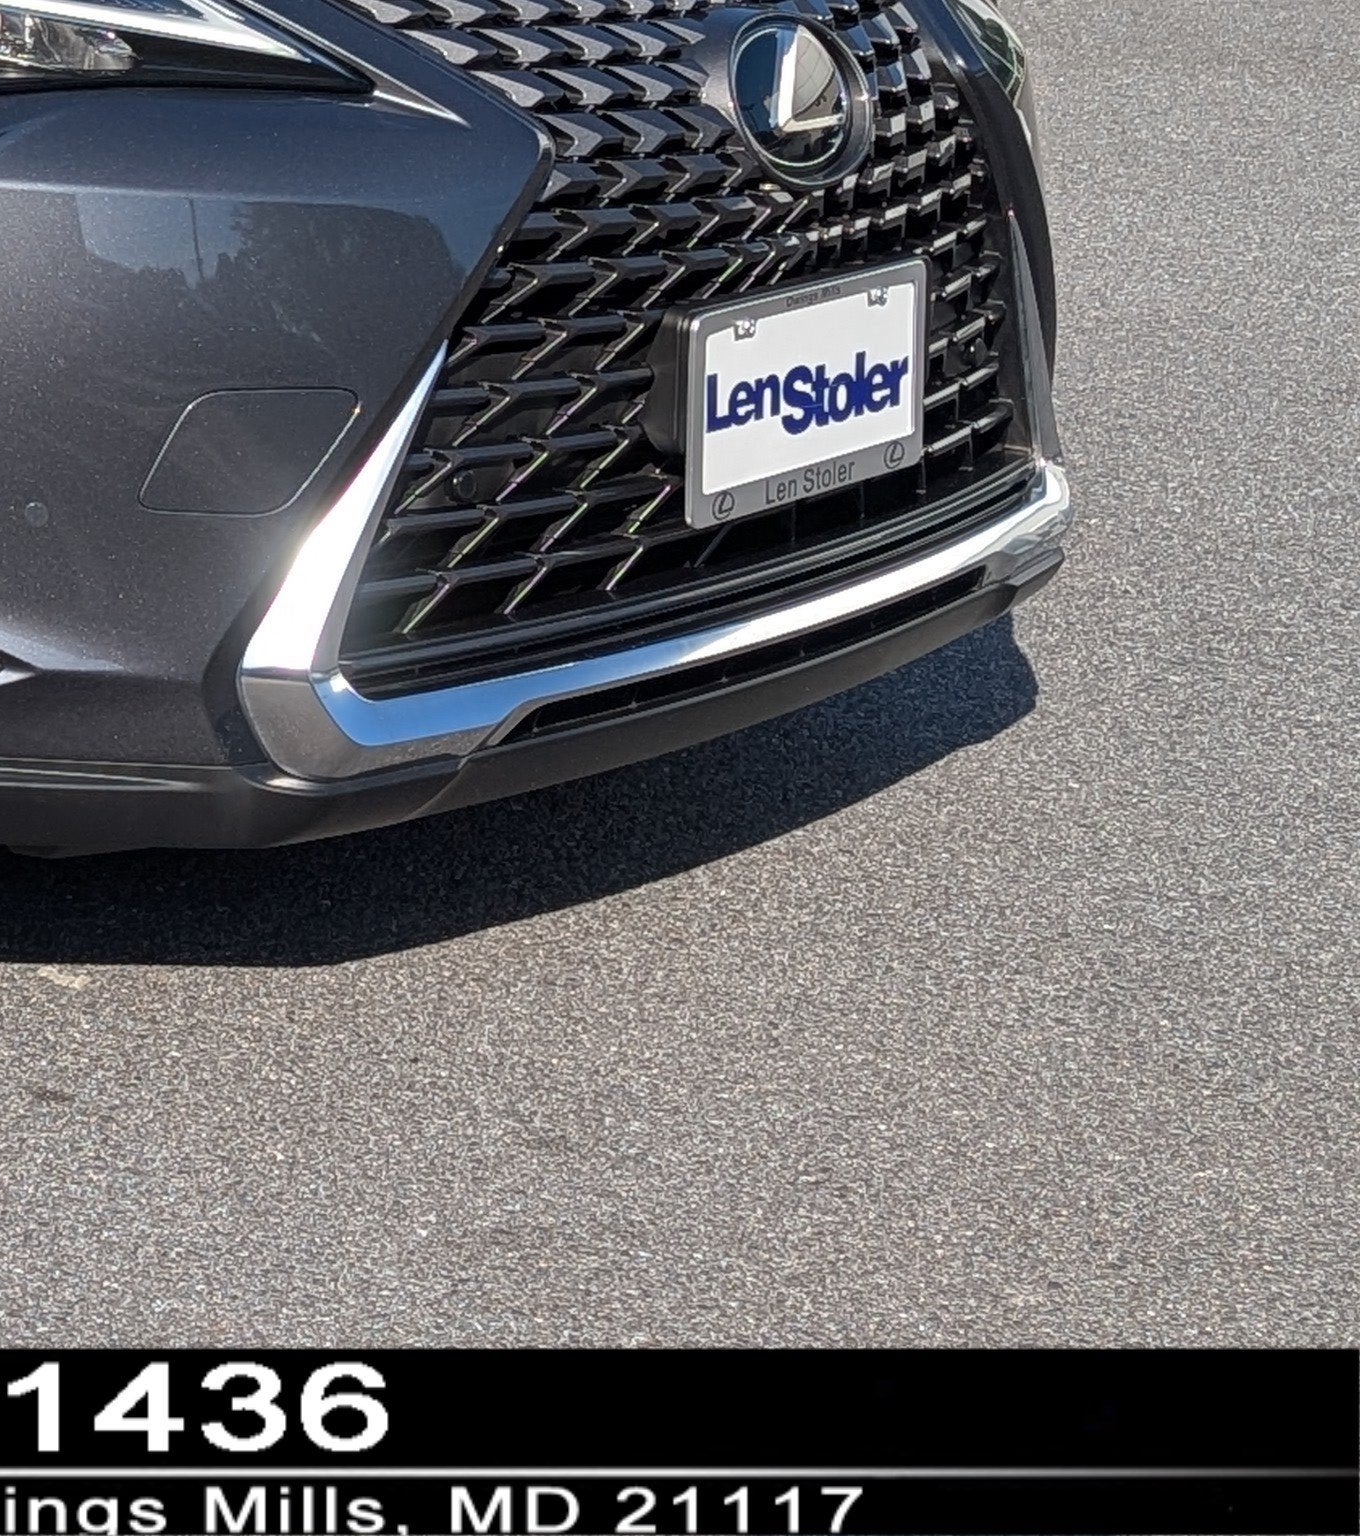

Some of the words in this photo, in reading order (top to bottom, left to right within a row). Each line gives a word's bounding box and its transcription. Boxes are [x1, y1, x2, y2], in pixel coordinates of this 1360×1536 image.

[706, 350, 909, 435] LenStoler
[765, 480, 797, 505] Len
[803, 460, 856, 494] Stoler
